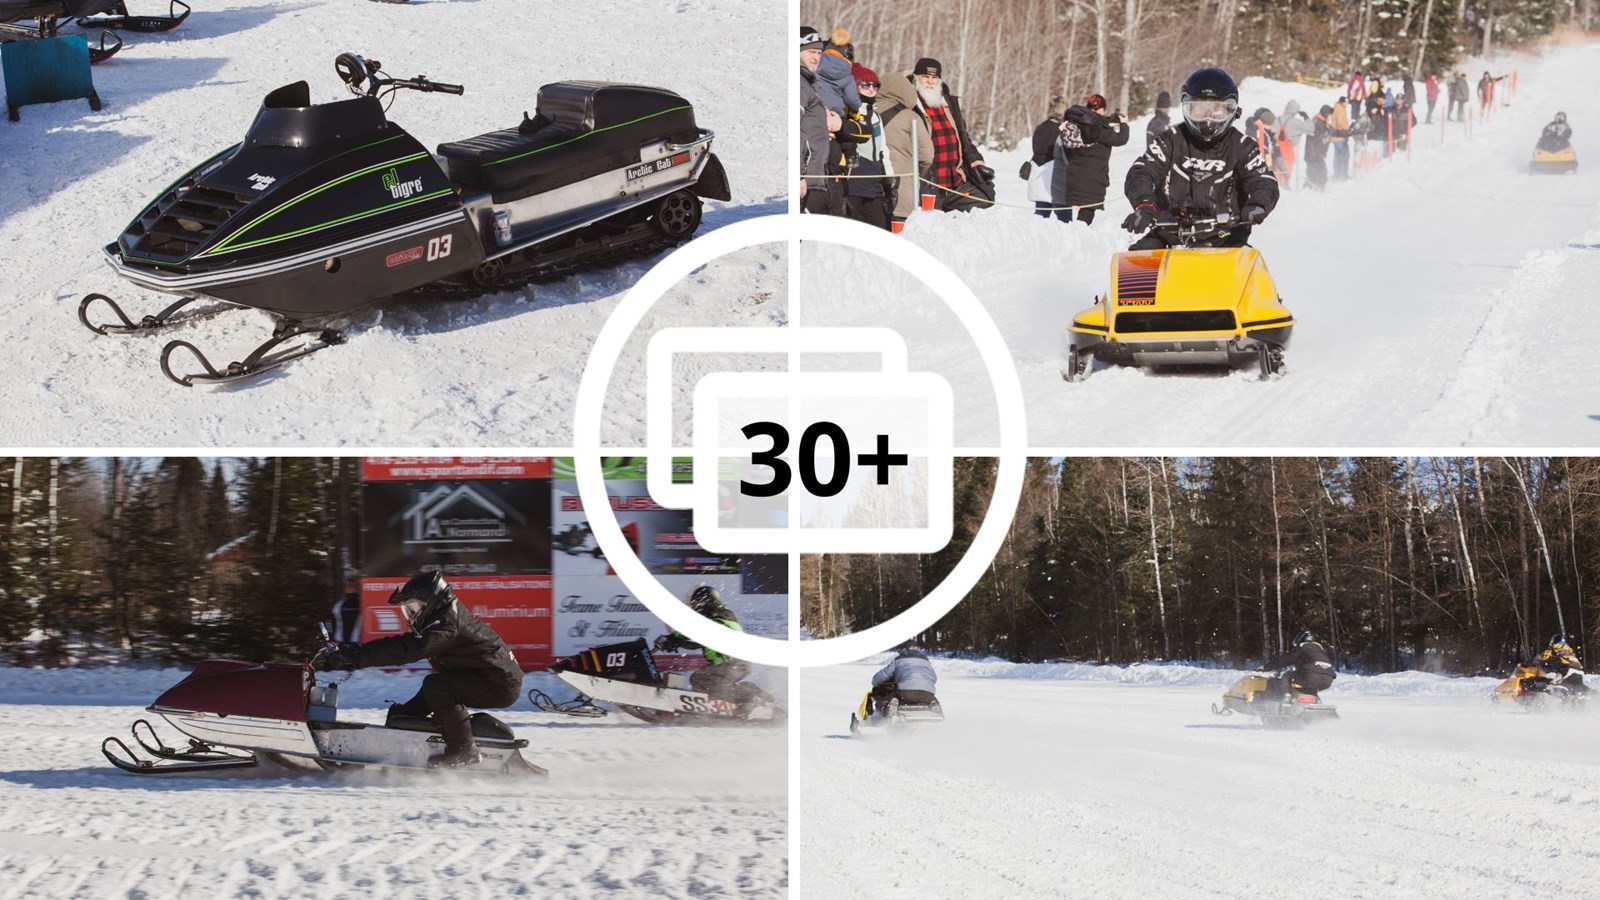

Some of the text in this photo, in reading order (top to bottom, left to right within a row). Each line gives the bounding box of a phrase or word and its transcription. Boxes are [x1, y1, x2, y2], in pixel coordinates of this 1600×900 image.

[626, 157, 672, 180] Arctic Cat
[1182, 157, 1226, 171] FXR
[382, 168, 400, 191] el
[427, 233, 453, 262] 03
[606, 652, 627, 668] 03
